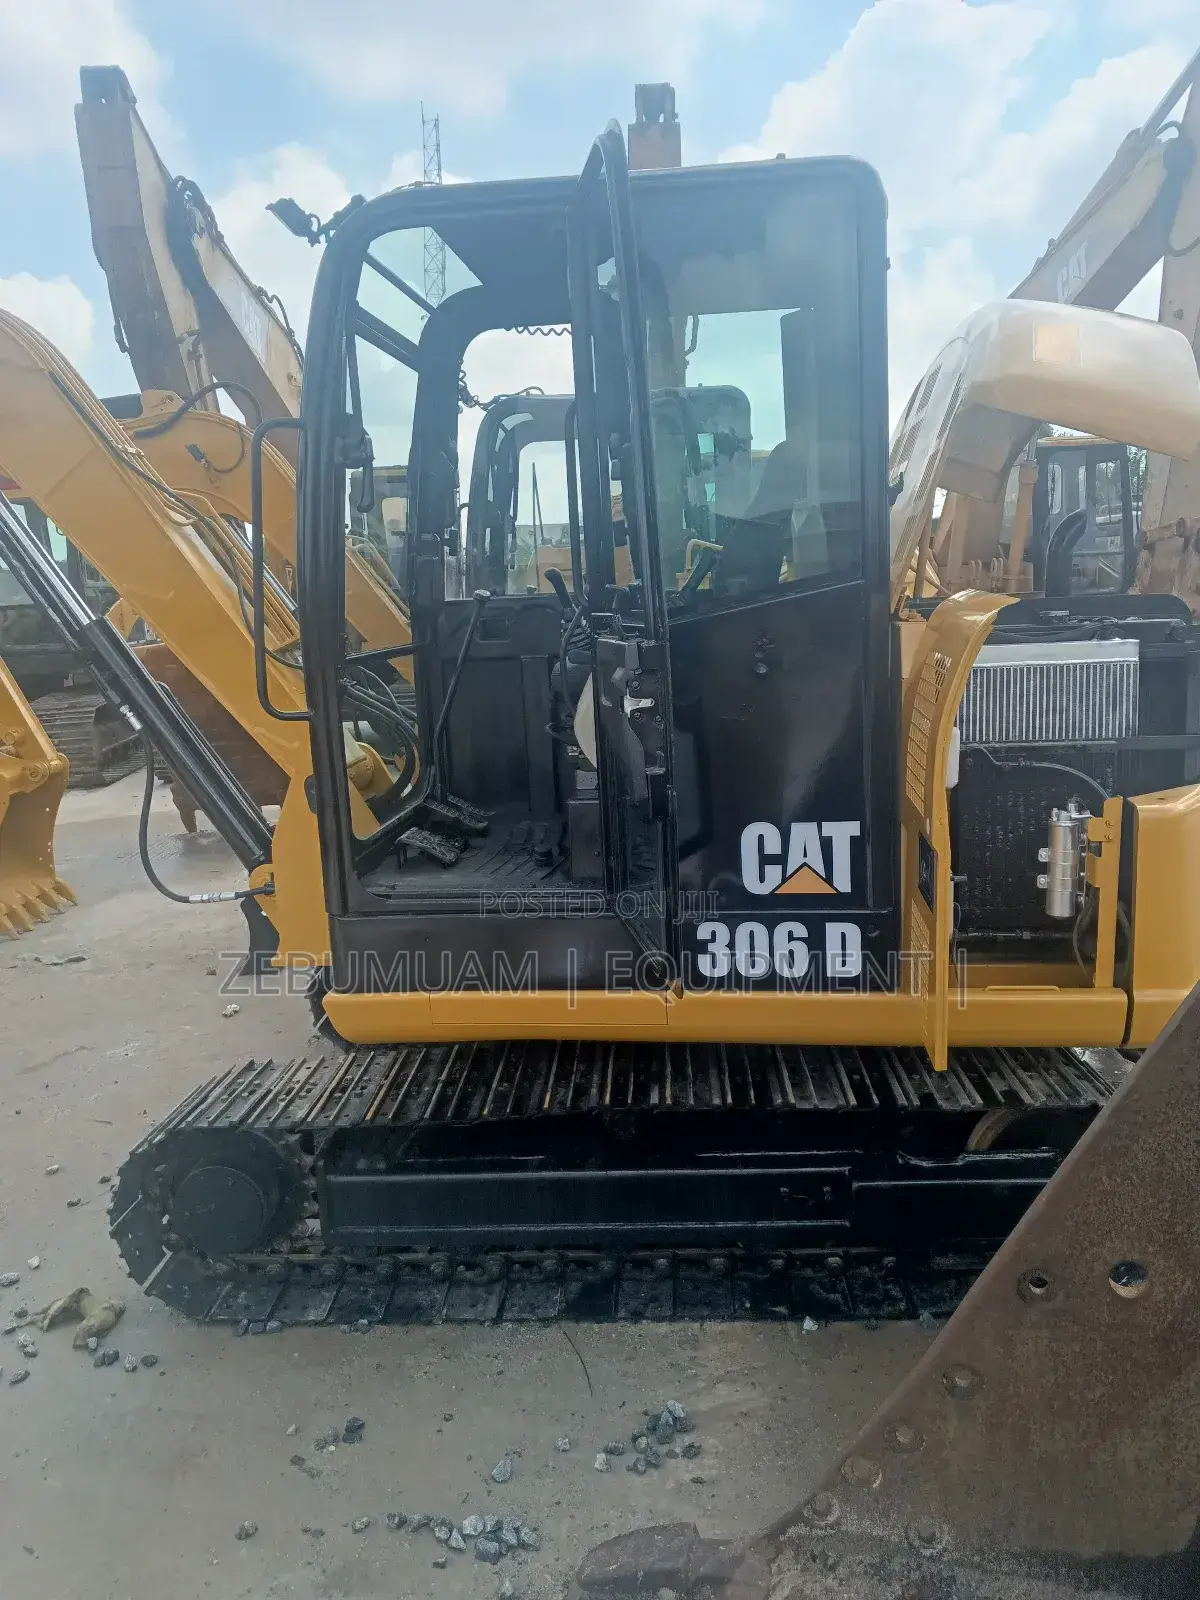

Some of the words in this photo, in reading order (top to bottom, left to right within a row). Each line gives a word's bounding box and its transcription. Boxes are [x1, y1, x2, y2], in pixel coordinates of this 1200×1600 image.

[1057, 236, 1088, 303] CAT
[740, 821, 861, 895] CAT
[696, 921, 810, 978] 306
[825, 922, 862, 977] D
